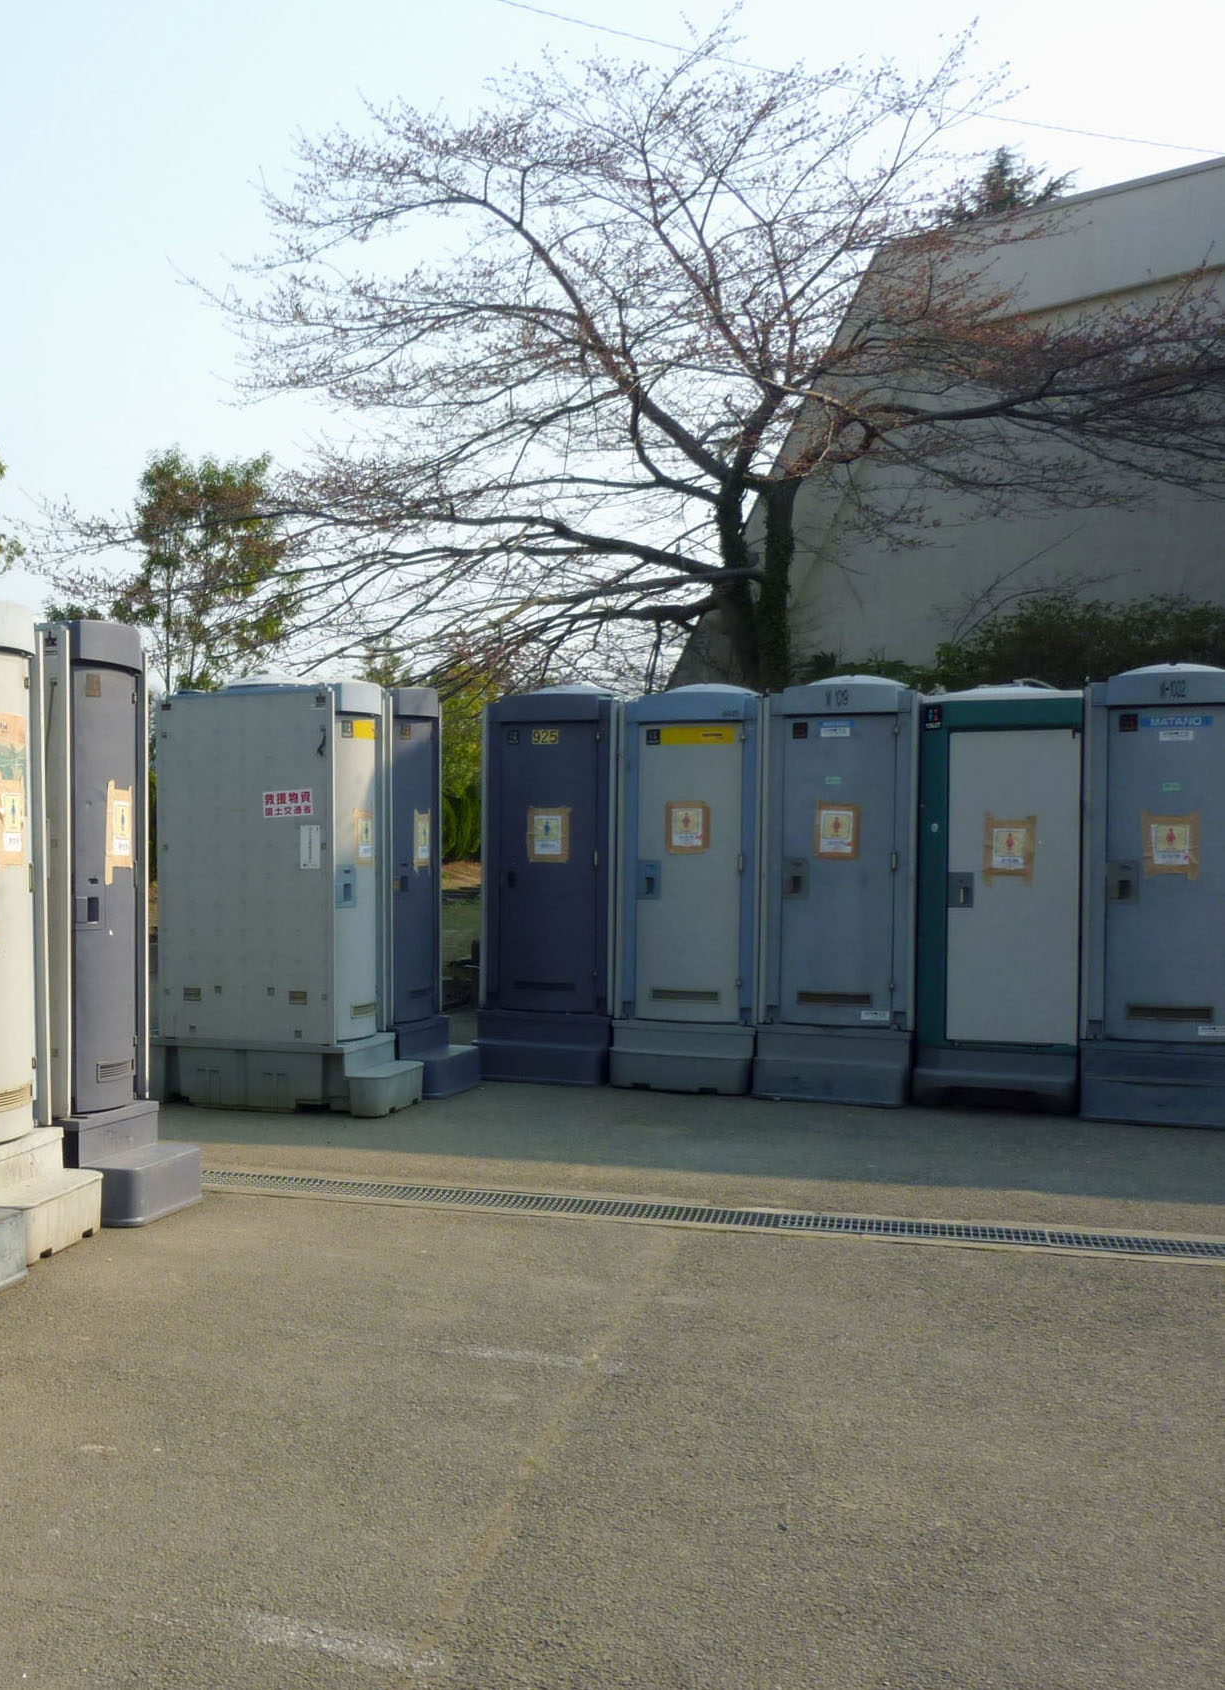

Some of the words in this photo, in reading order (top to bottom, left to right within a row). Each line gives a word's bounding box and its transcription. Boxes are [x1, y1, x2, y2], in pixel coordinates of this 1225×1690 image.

[1150, 716, 1202, 727] MATANO
[532, 730, 559, 744] 925
[264, 791, 311, 806] 救援物資
